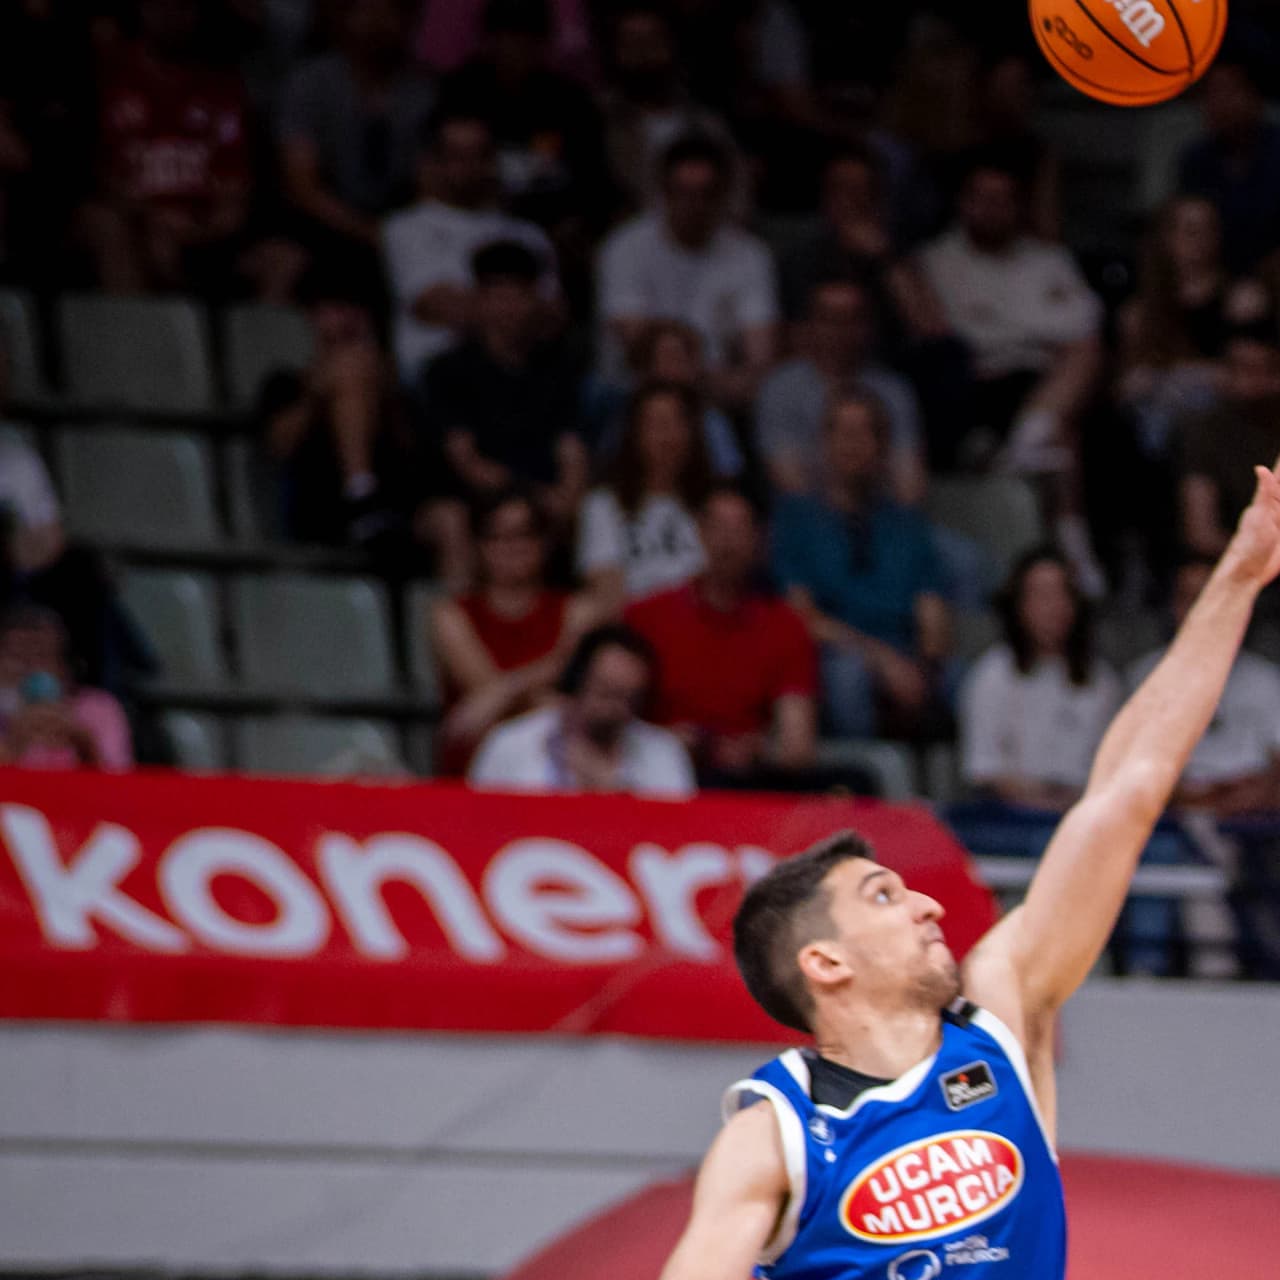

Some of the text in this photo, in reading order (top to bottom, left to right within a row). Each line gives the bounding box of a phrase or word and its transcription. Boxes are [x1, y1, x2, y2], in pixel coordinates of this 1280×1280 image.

[3, 803, 775, 964] koner
[862, 1164, 1014, 1234] MURCIA
[869, 1137, 994, 1204] UCAM
